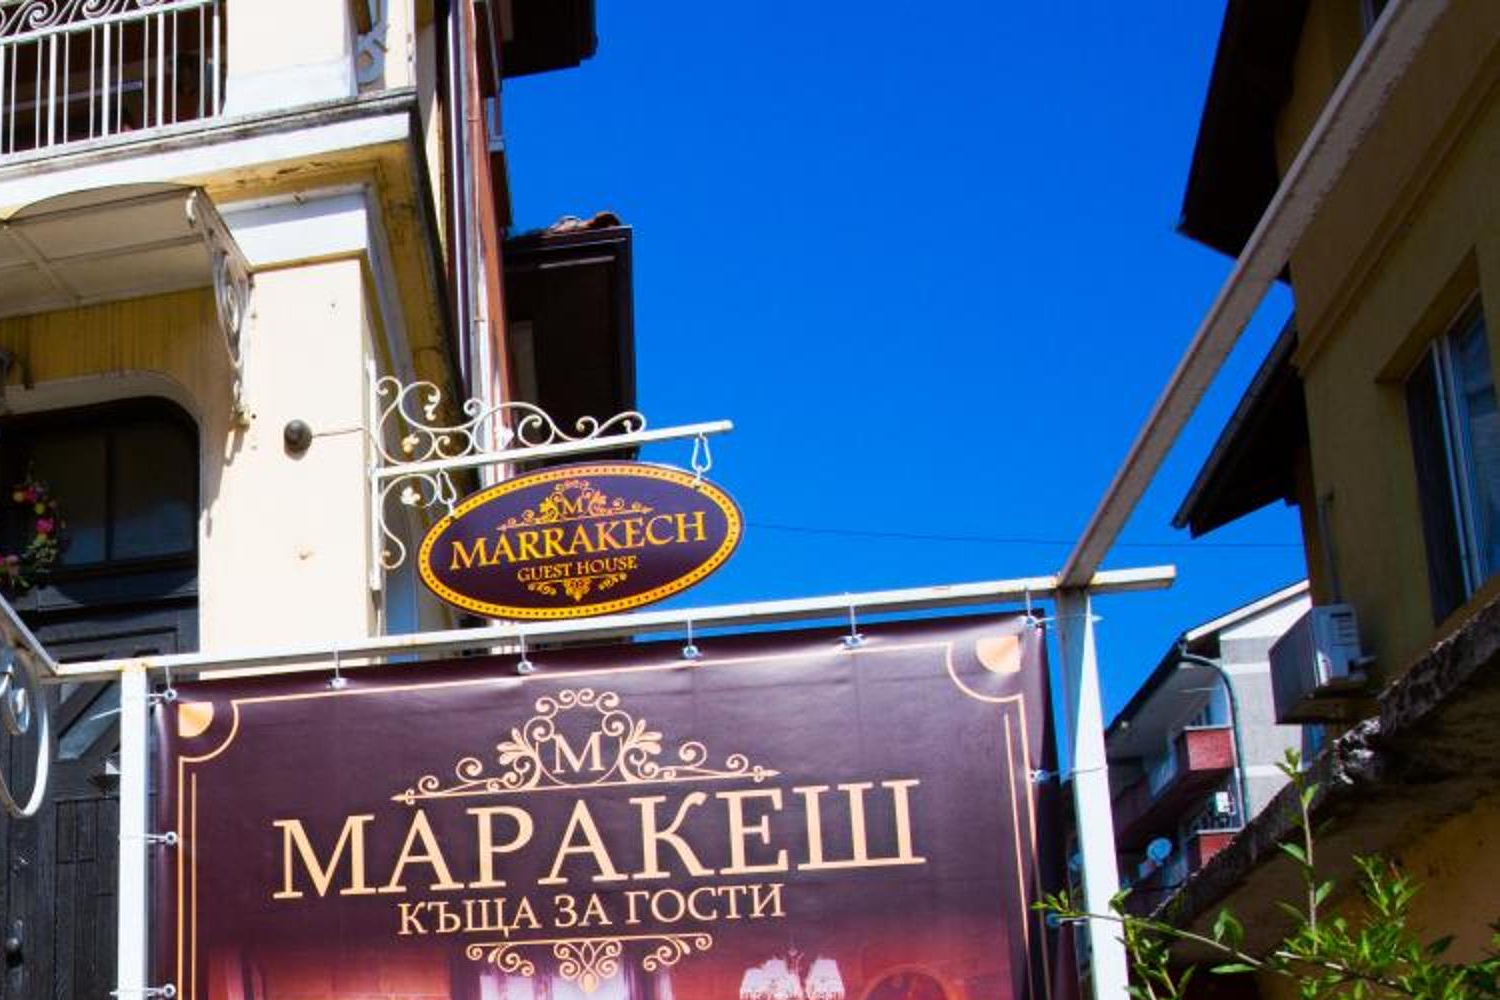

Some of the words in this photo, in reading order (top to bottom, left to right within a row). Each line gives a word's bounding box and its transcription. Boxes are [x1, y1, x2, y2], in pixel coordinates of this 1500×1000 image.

[562, 497, 584, 515] M
[449, 511, 708, 571] MARRAKECH
[516, 561, 574, 582] GUEST
[576, 555, 638, 576] HOUSE
[271, 778, 927, 899] МАРАКЕШ
[398, 895, 542, 938] КЪЩА
[556, 891, 614, 929] ЗА
[624, 883, 787, 925] ГОСТИ
